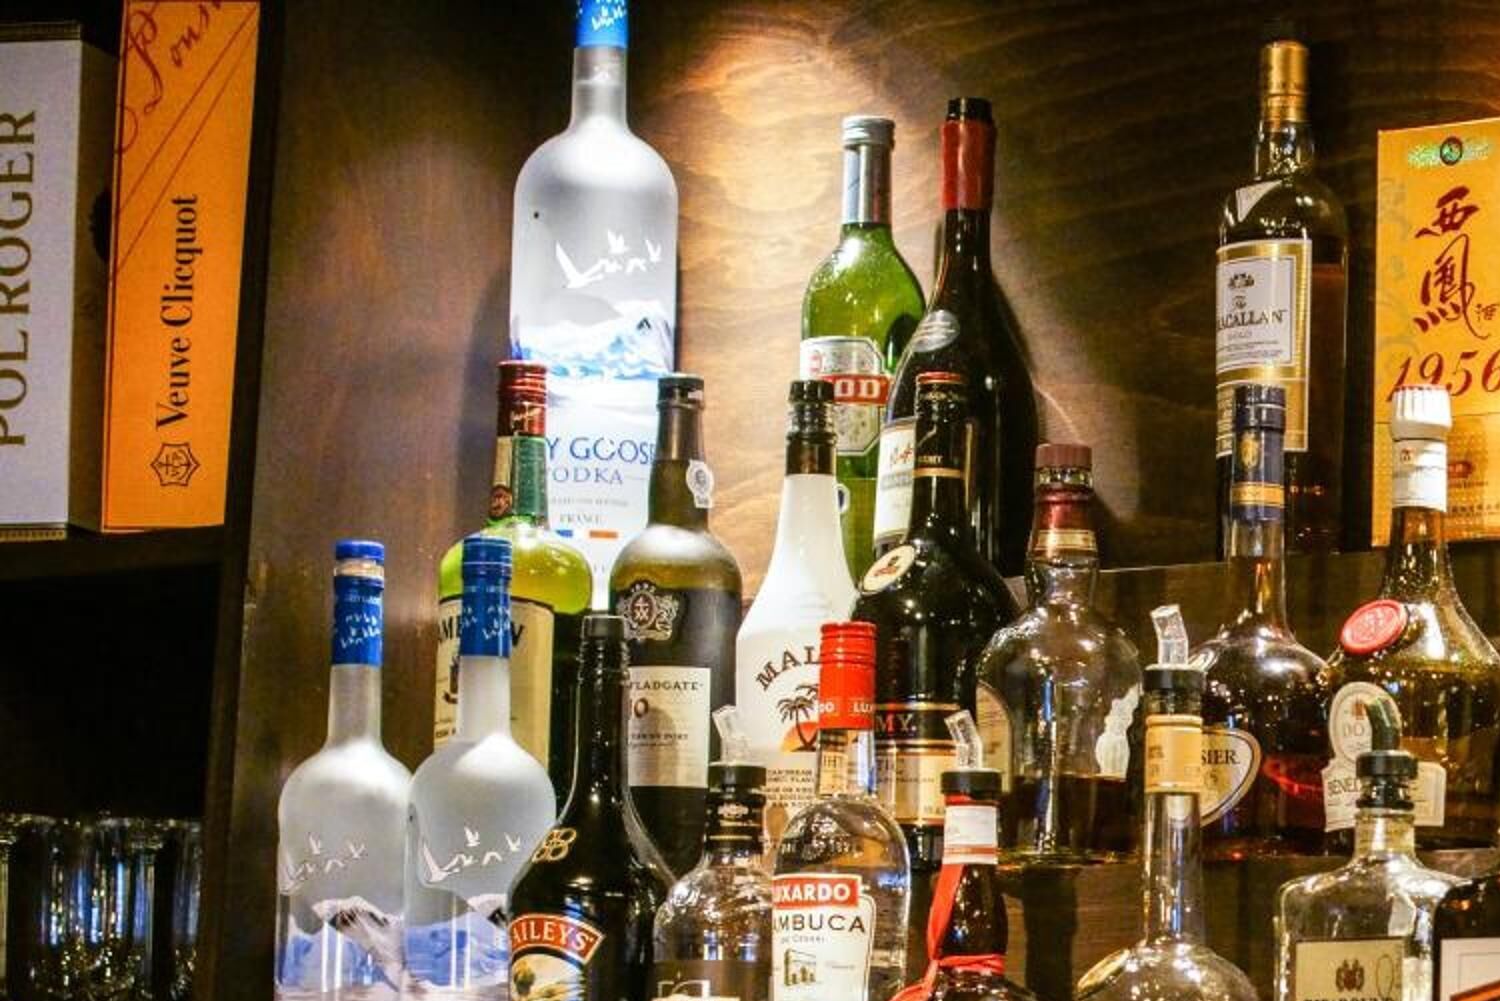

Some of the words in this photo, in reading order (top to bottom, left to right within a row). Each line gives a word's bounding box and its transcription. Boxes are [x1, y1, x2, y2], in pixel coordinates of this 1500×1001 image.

[0, 110, 35, 314] ROGER
[160, 194, 203, 327] Clicquot
[155, 338, 192, 429] Veuve
[756, 646, 821, 691] MAL
[512, 919, 591, 950] AILEYS
